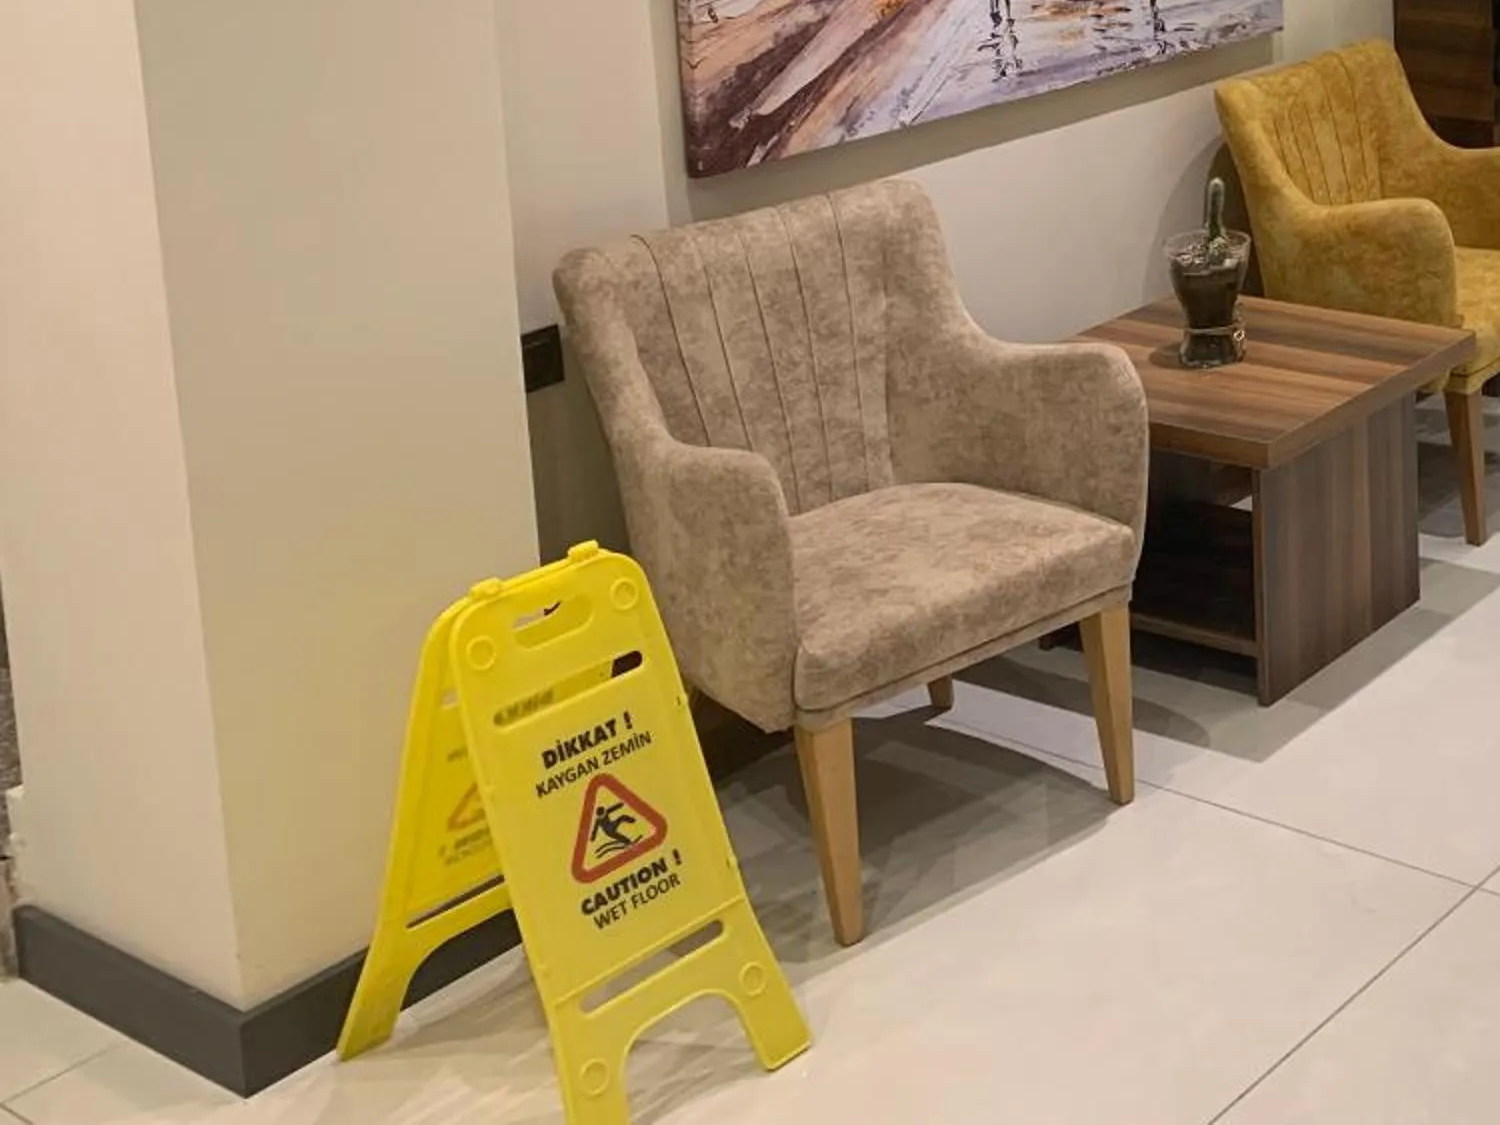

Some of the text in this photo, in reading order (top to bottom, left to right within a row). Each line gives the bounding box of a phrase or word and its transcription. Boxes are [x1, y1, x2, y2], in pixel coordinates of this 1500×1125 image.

[535, 730, 652, 799] KAYGAN ZEMİN
[541, 711, 633, 769] DİKKAT !
[581, 848, 682, 916] CAUTION !
[593, 873, 681, 930] WET FLOOR
